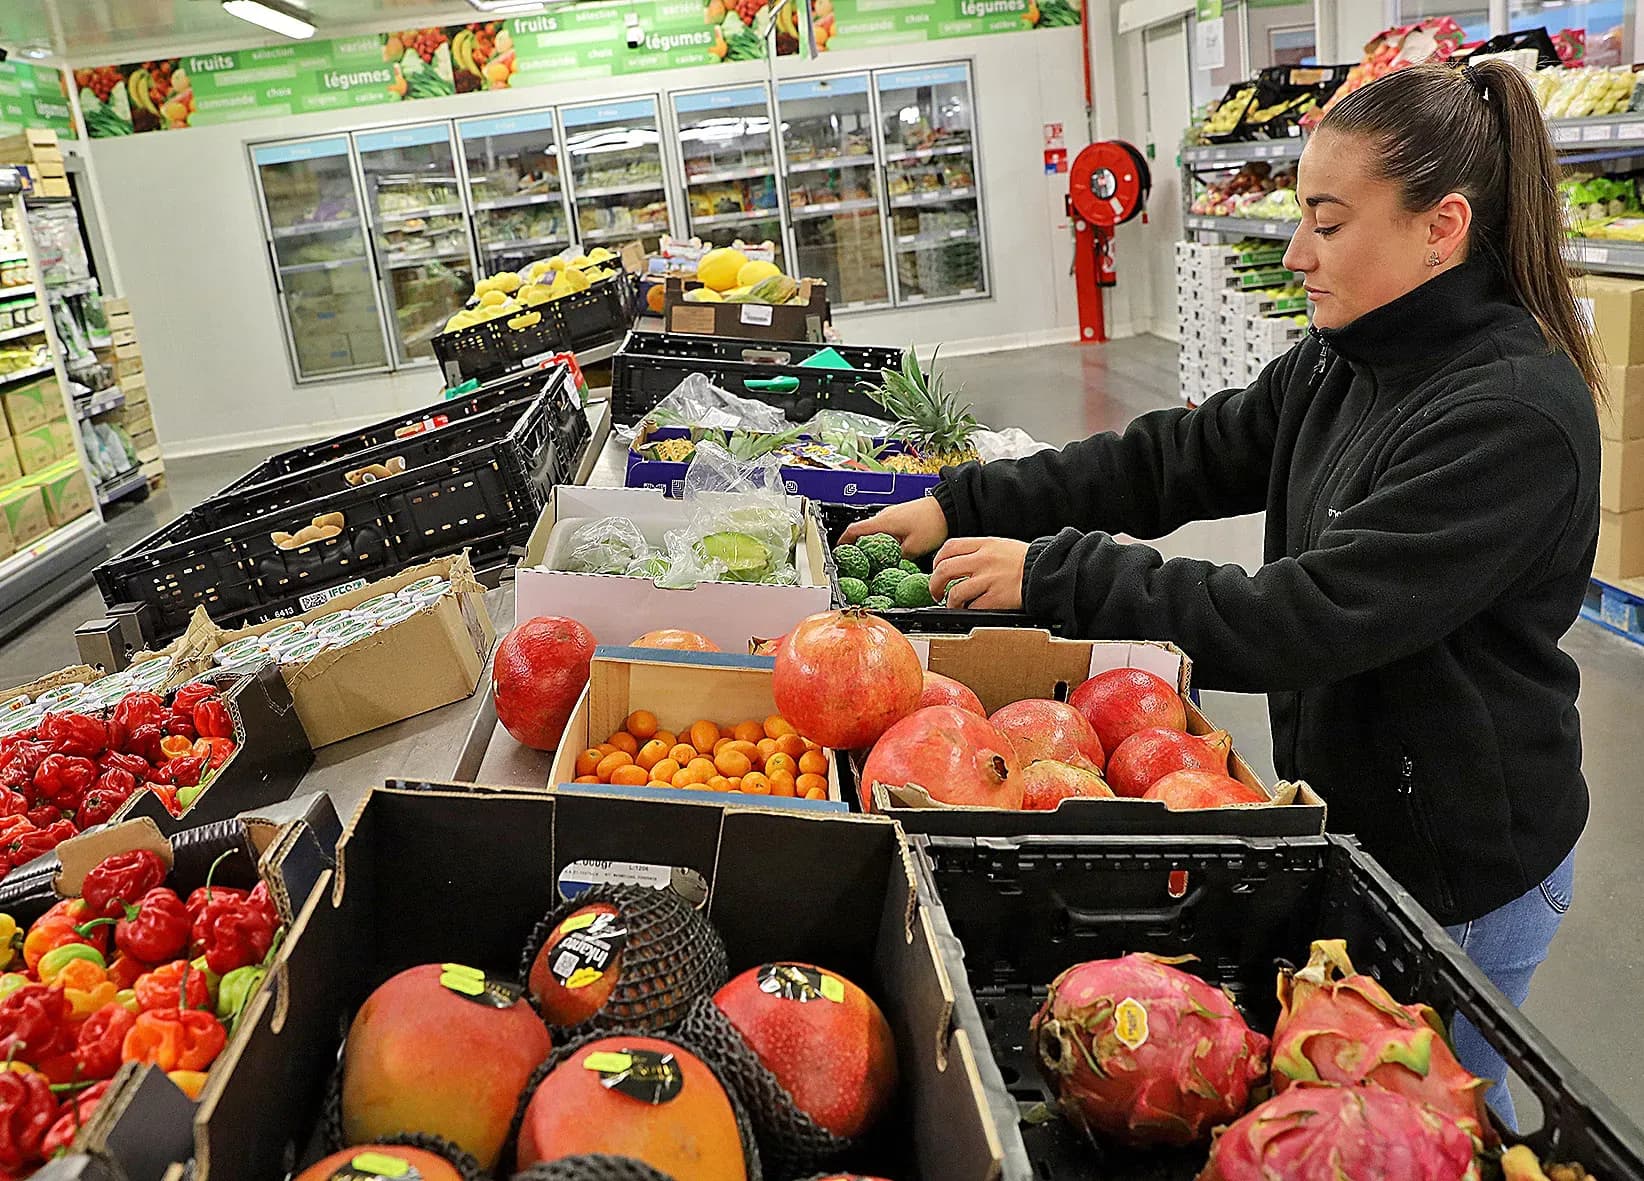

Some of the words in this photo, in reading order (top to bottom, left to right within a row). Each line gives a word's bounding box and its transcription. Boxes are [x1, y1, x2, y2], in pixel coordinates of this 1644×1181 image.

[961, 0, 1026, 17] légumes
[514, 17, 558, 34] fruits
[645, 31, 712, 52] légumes
[190, 55, 235, 74] fruits
[324, 68, 392, 90] légumes
[265, 86, 293, 98] choix
[328, 584, 353, 598] IFCO
[259, 614, 271, 623] LL
[274, 606, 295, 618] 6413
